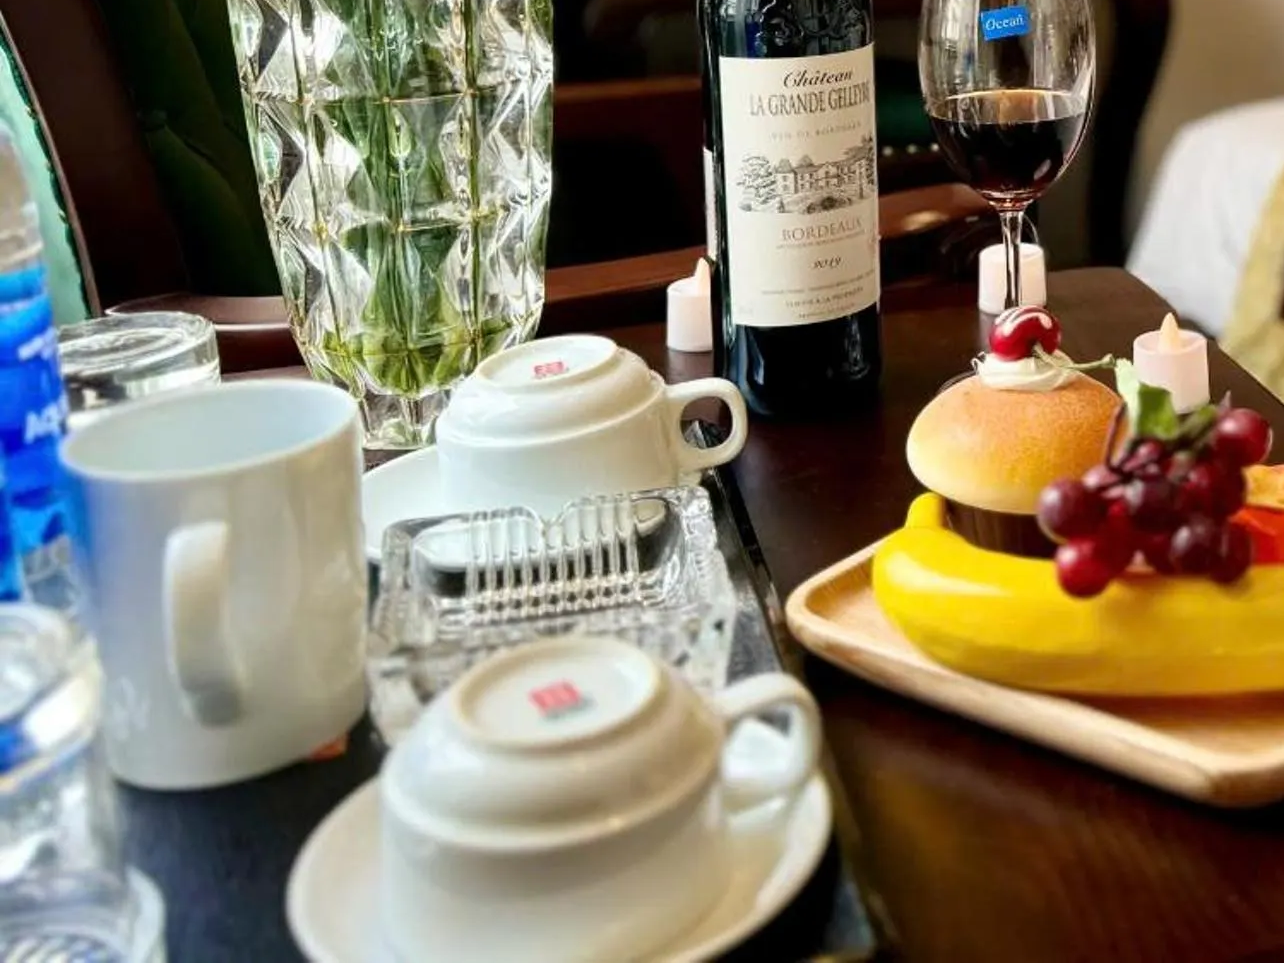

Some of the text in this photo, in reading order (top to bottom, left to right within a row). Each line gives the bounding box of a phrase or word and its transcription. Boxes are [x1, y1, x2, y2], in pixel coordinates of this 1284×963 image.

[985, 16, 1025, 31] Ocean
[749, 93, 765, 117] LA
[767, 91, 826, 117] GRANDE
[781, 217, 862, 242] BORDEAUX
